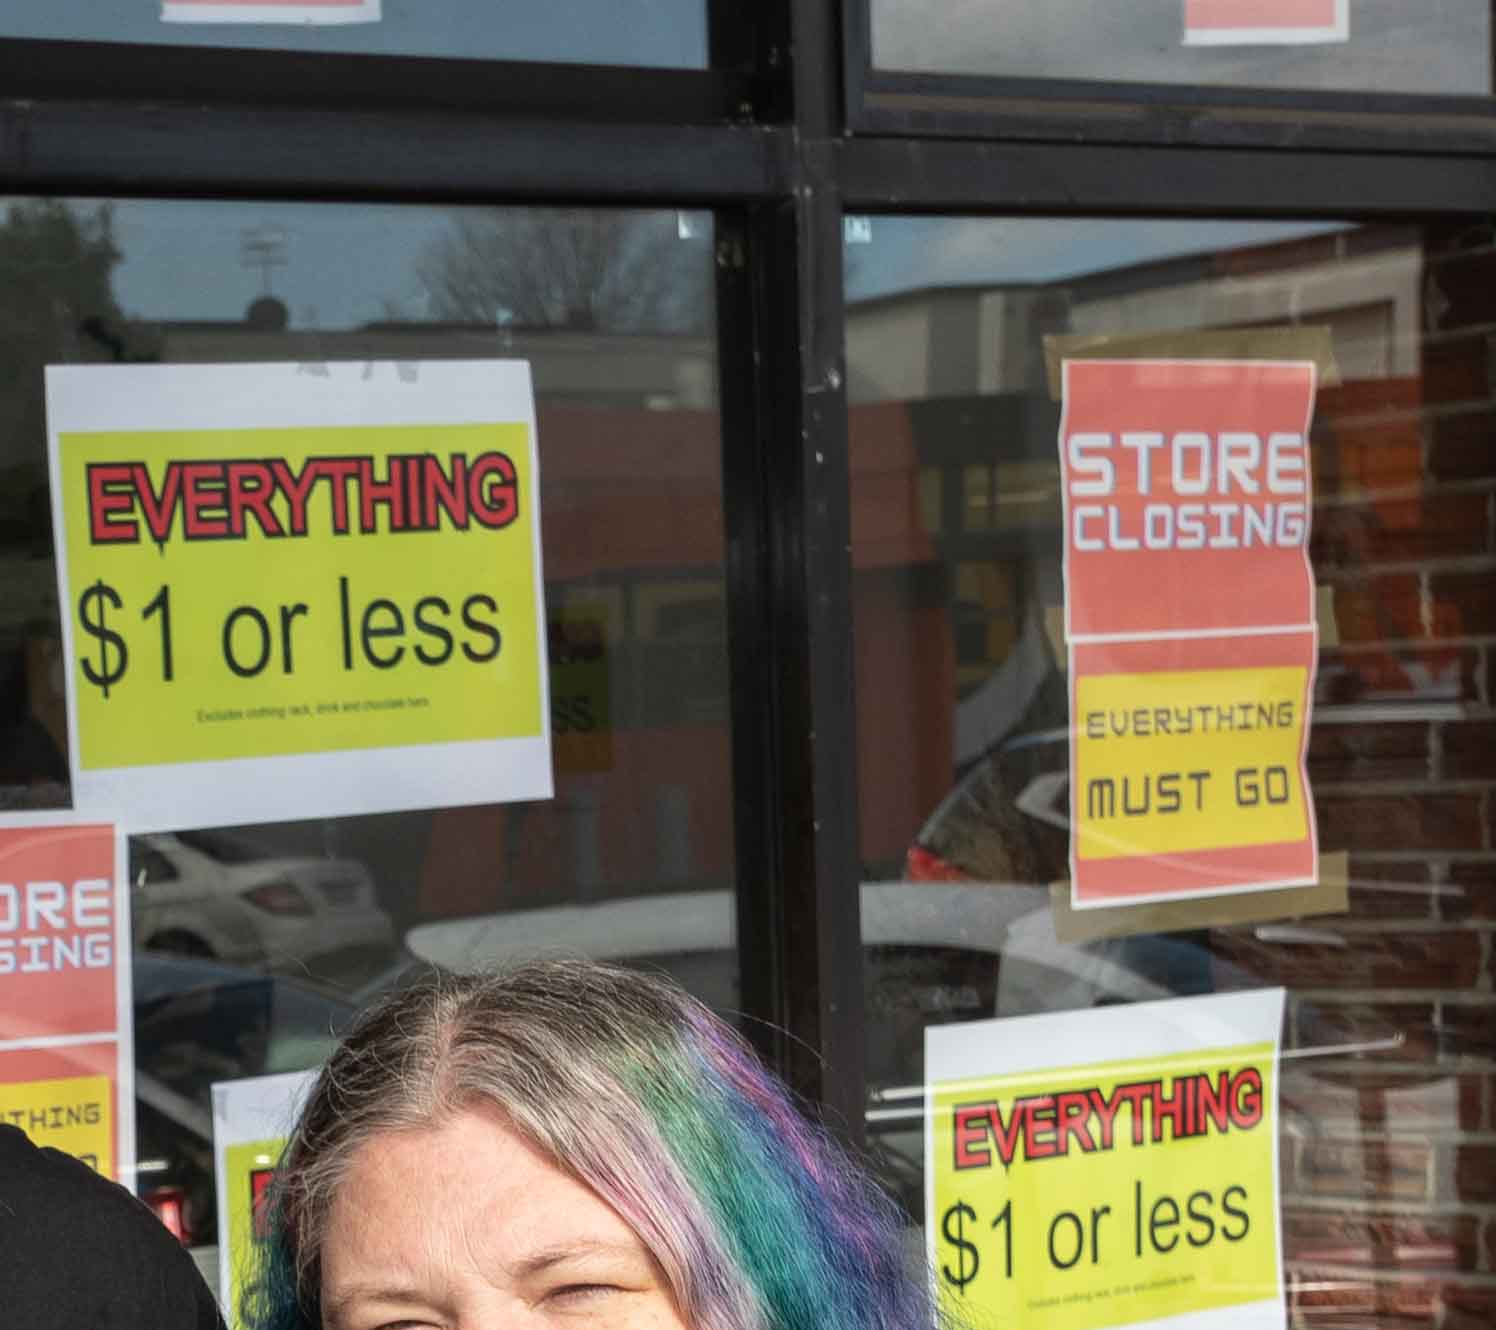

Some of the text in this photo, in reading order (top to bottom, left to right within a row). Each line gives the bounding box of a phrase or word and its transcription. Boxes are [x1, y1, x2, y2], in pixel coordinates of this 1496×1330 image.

[86, 451, 519, 555] EVERYTHING
[1068, 432, 1305, 496] STORE
[1072, 502, 1305, 552] CLOSING
[78, 578, 173, 699] $1
[221, 602, 309, 679] or
[339, 575, 503, 671] less
[1086, 701, 1294, 740] EVERYTHING
[1088, 765, 1291, 820] MUST GO
[953, 1066, 1263, 1175] EVERYTHING
[941, 1199, 1013, 1296] $1
[1048, 1204, 1111, 1270] or
[1135, 1180, 1250, 1258] less
